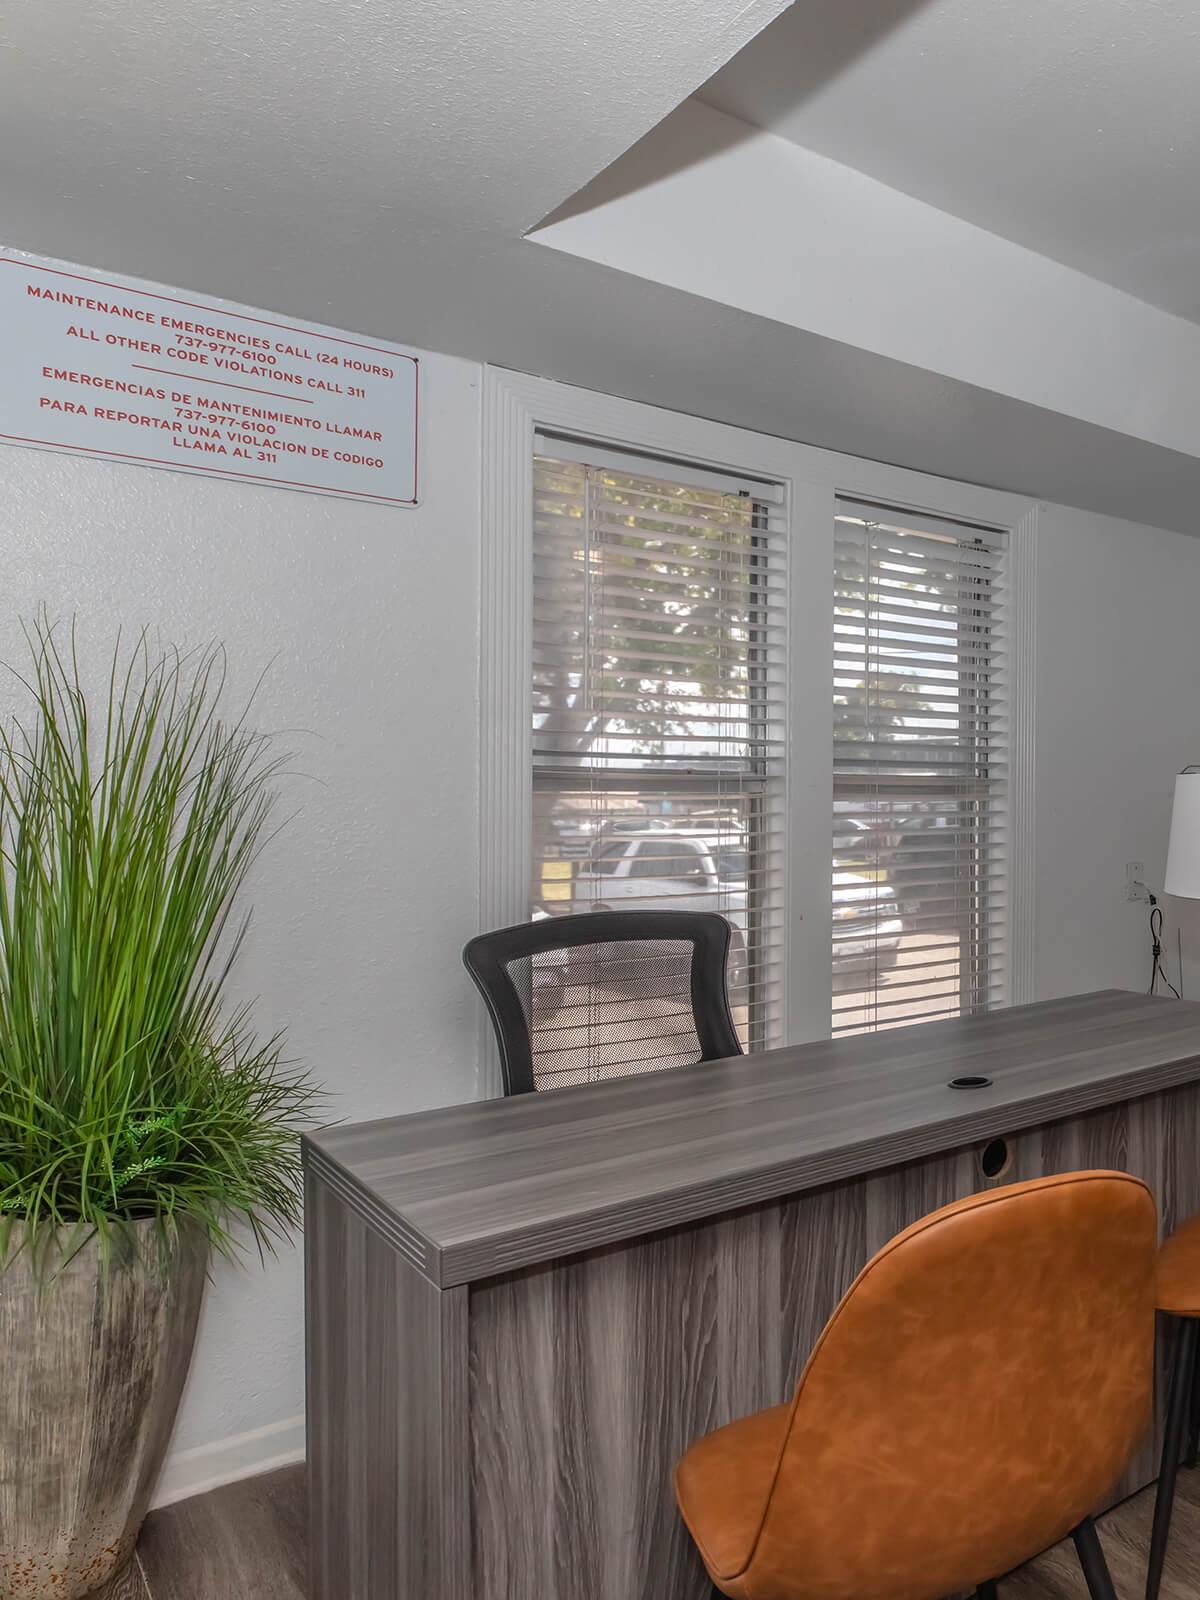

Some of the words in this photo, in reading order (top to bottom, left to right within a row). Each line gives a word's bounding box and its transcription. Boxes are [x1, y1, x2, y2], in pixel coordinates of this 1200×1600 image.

[27, 285, 155, 323] MAINTENANCE
[161, 316, 270, 349] EMERGENCIES
[275, 343, 312, 359] CALL
[317, 352, 338, 365] (24
[343, 358, 394, 379] HOURS)
[66, 326, 100, 341] ALL
[105, 334, 161, 354] OTHER
[167, 347, 209, 365] CODE
[214, 357, 303, 385] VIOLATIONS
[307, 378, 343, 394] CALL
[347, 387, 365, 398] 311
[175, 334, 276, 365] 737-977-6100
[39, 397, 87, 415] PARA
[94, 407, 182, 432] REPORTAR
[188, 424, 221, 439] UNA
[226, 431, 307, 455] VIOLACION
[311, 447, 329, 459] DE
[334, 451, 384, 468] CODIGO
[42, 366, 166, 400] EMERGENCIAS
[171, 392, 192, 404] DE
[197, 397, 321, 429] MANTENIMIENTO
[326, 422, 382, 442] LLAMAR
[174, 407, 276, 434] 737-977-6100
[173, 436, 227, 455] LLAMA
[232, 447, 252, 459] AL
[257, 452, 277, 463] 311
